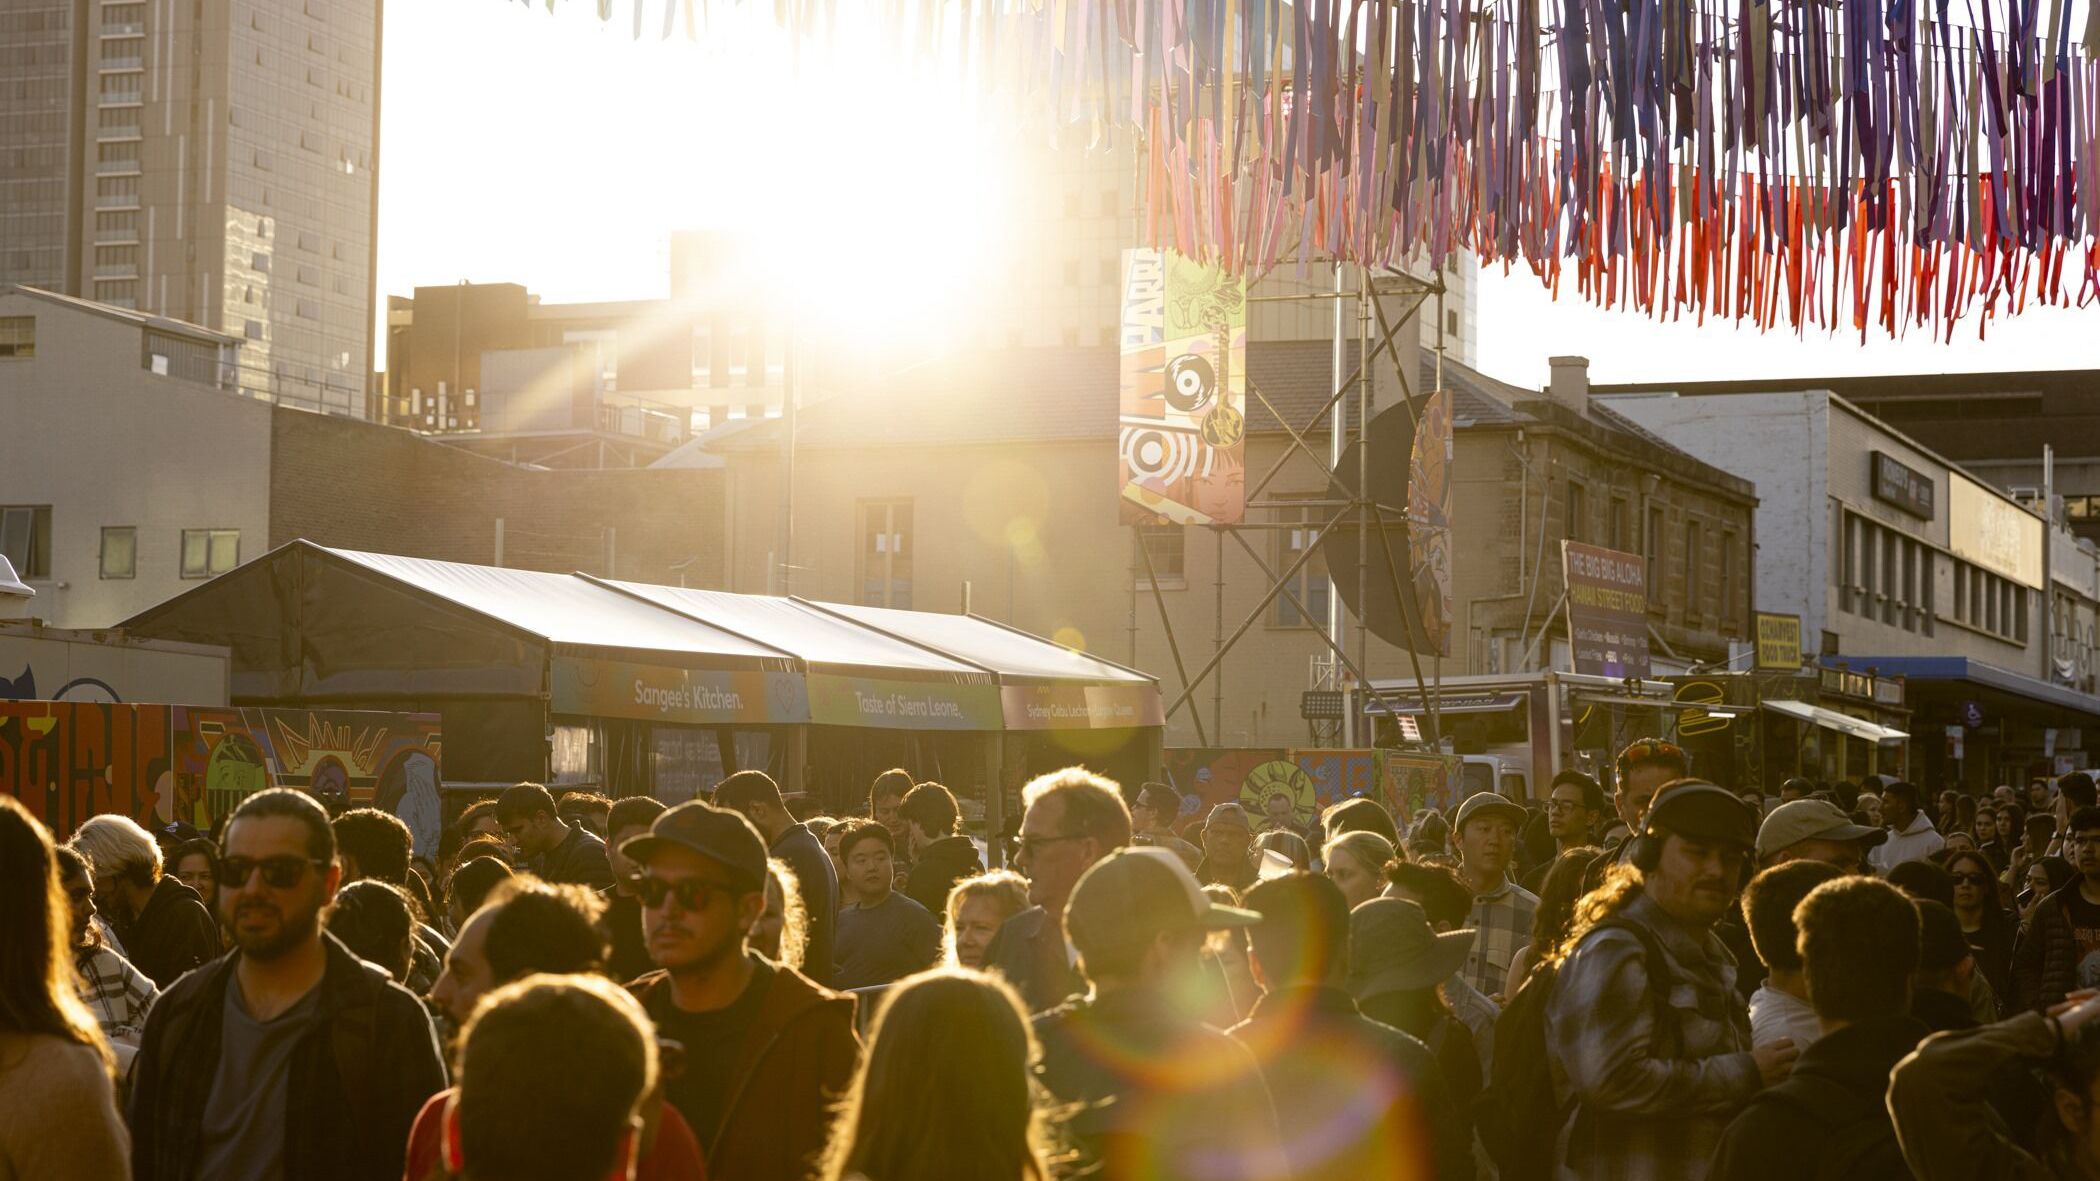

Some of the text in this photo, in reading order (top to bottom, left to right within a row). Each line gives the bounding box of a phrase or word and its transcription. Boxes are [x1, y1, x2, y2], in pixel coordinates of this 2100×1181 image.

[1568, 551, 1642, 587] THE BIG BIG ALOHA
[1597, 587, 1623, 611] STREET
[1623, 591, 1645, 614] FOOD
[1761, 642, 1778, 663] FOOD
[634, 679, 744, 712] Sangee's Kitchen.
[855, 691, 964, 719] Taste of Sierra Leone.
[1026, 703, 1051, 721] Sydney
[1051, 703, 1068, 718] Cebu
